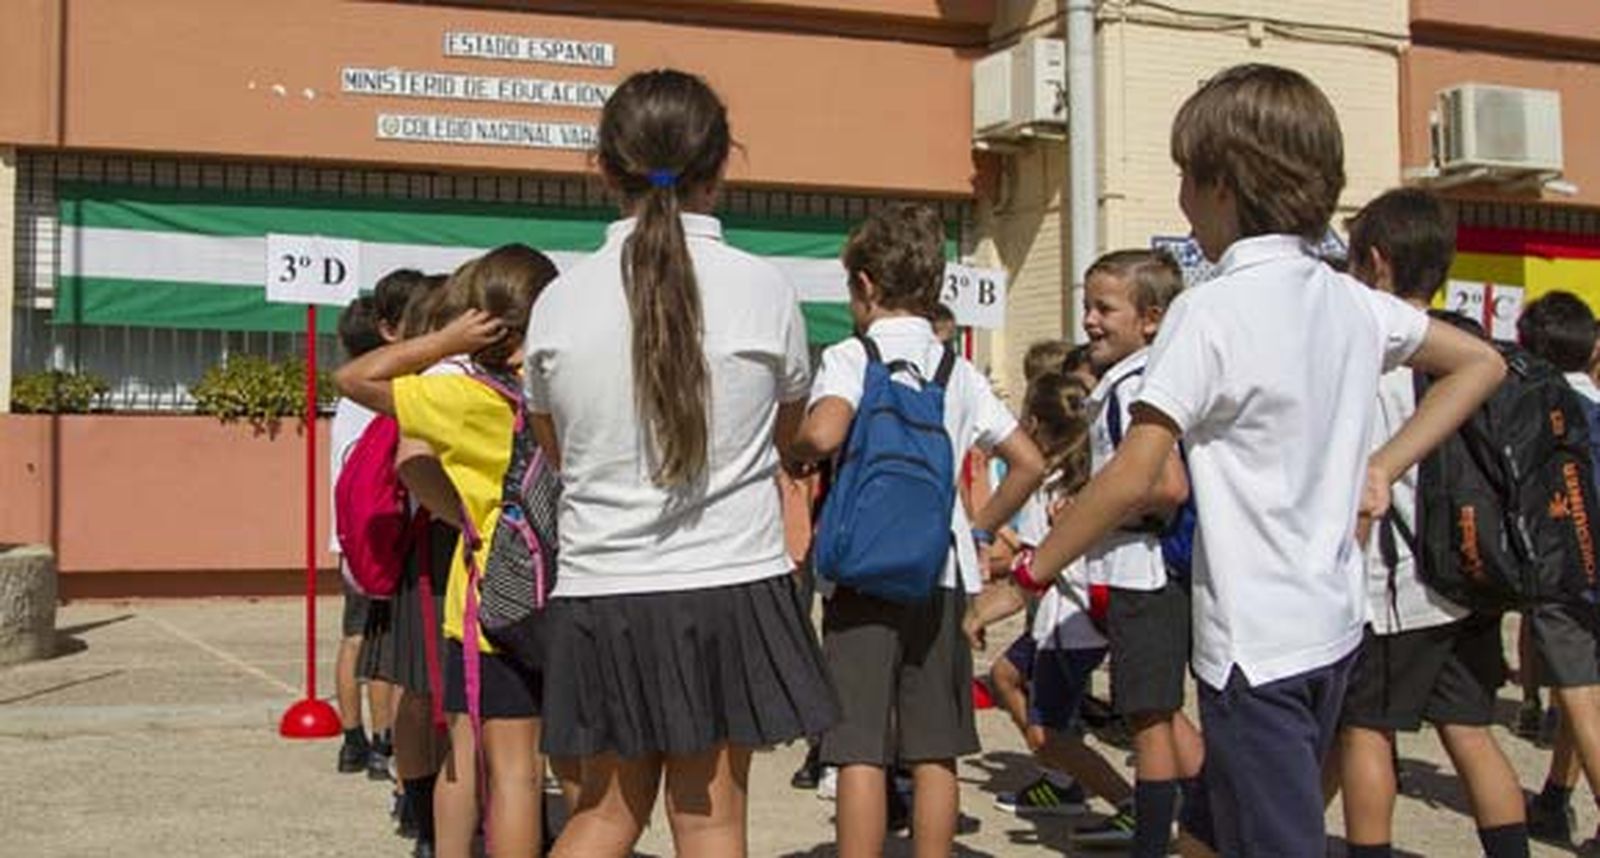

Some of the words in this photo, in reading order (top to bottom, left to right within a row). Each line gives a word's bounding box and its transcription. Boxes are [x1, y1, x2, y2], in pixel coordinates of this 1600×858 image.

[449, 34, 520, 56] ESTADO
[344, 71, 456, 95] MINISTERIO
[463, 78, 489, 97] DE
[402, 117, 472, 140] COLEGIO
[475, 121, 552, 144] NACIONAL
[322, 256, 347, 285] D
[978, 278, 997, 306] B
[1492, 294, 1516, 322] C
